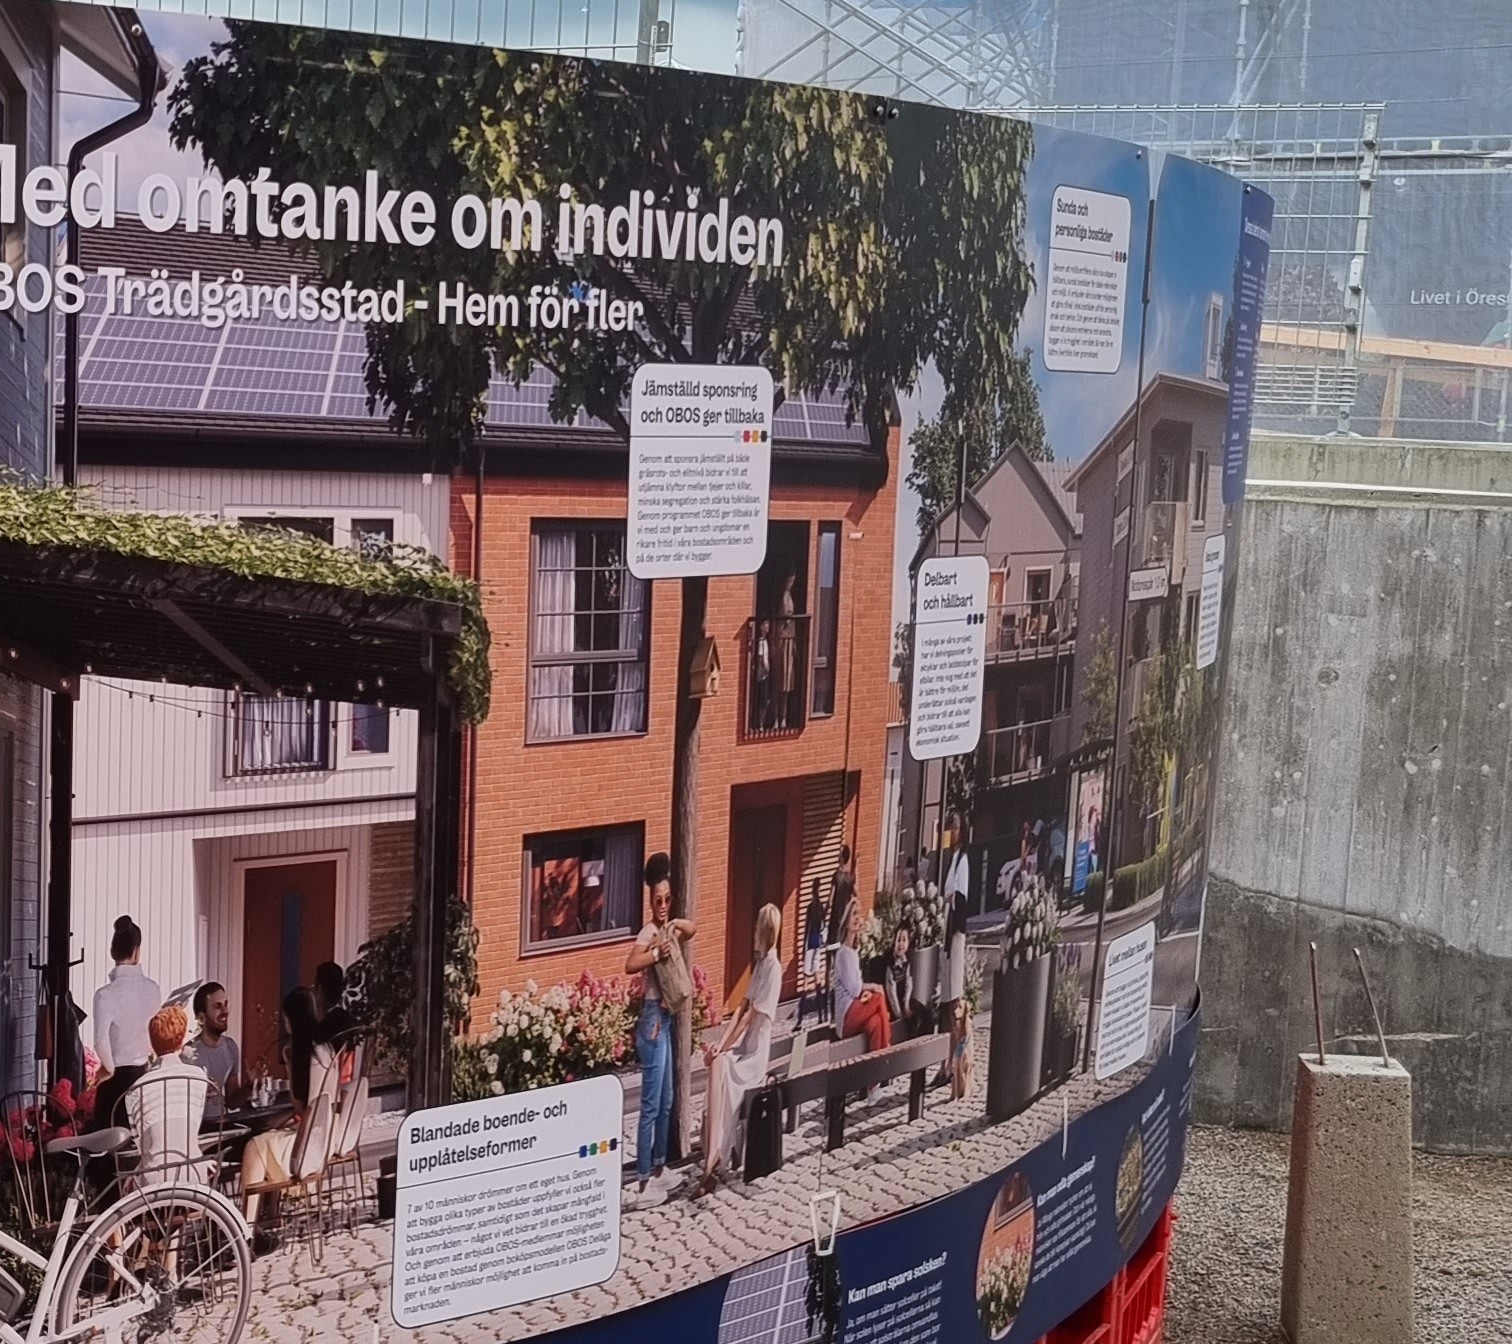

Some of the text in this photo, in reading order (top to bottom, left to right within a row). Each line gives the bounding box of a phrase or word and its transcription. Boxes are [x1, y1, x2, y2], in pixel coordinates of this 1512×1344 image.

[137, 167, 437, 247] omtanke
[451, 192, 543, 252] om
[557, 182, 784, 267] individen
[97, 266, 405, 329] Trädgårdsstad
[438, 280, 519, 327] Hem
[528, 284, 579, 330] för
[585, 286, 644, 332] fler
[1410, 289, 1451, 305] Livet
[641, 379, 758, 402] Jämställd sponsring
[640, 406, 766, 428] och OBOS ger tillbaka
[924, 571, 958, 587] Delbart
[410, 1099, 568, 1145] Blandade boende- och
[409, 1135, 538, 1174] upplåtelseformer
